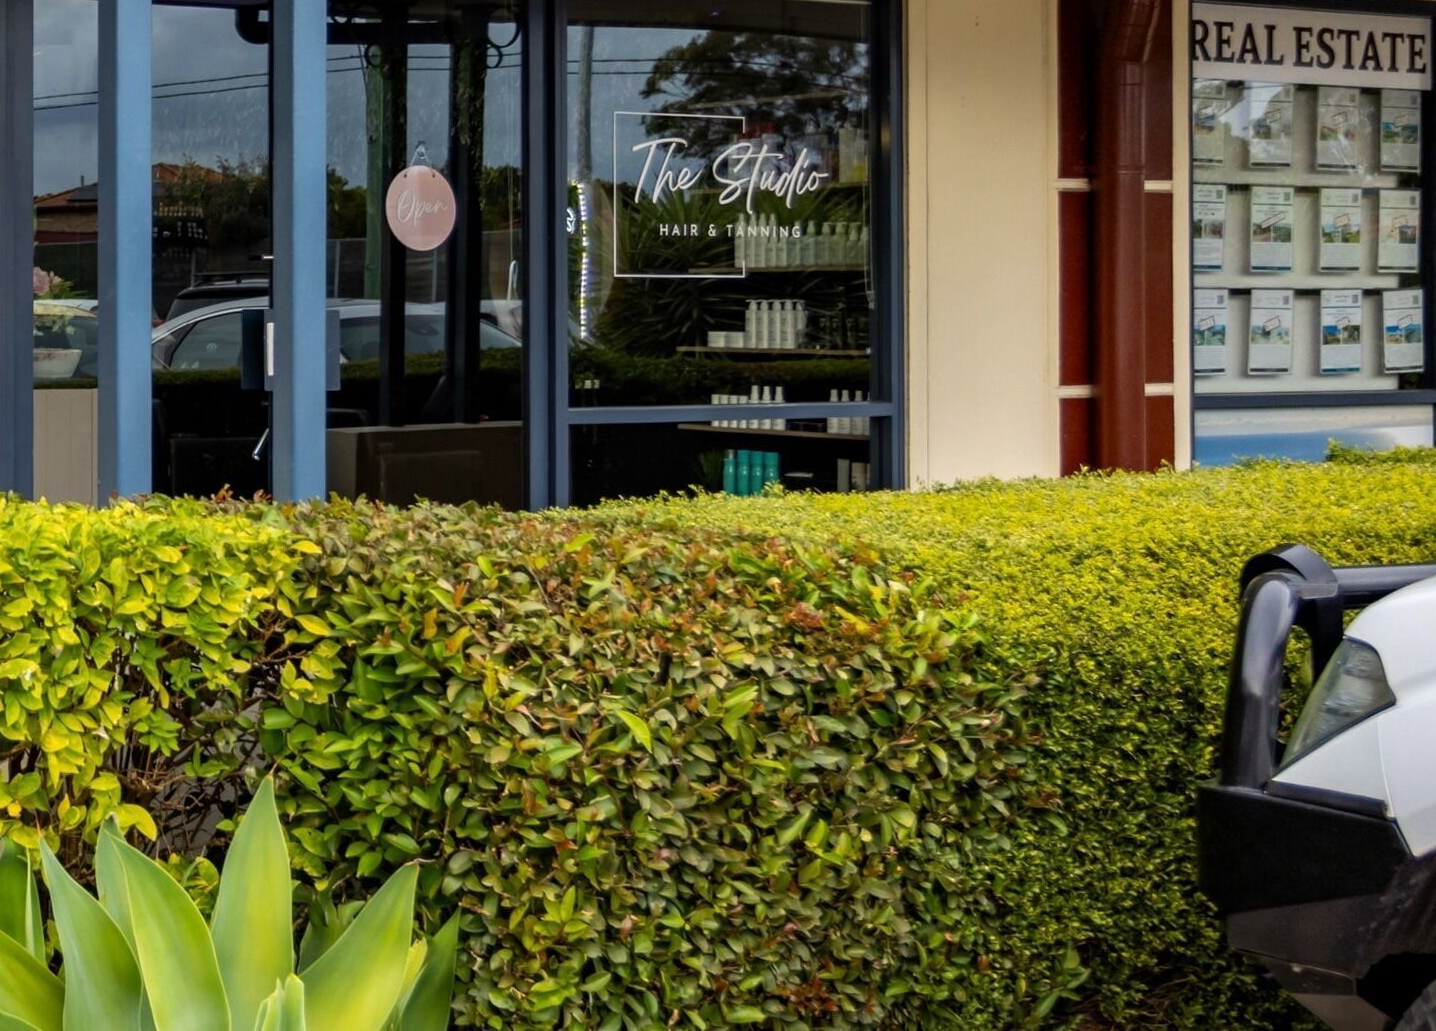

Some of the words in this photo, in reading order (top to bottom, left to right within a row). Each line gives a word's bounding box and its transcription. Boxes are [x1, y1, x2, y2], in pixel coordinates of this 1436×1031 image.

[1191, 19, 1285, 67] REAL
[1292, 25, 1427, 74] ESTATE
[631, 137, 703, 204] The
[711, 142, 829, 213] Studio
[395, 188, 449, 227] Open
[658, 222, 699, 237] HAIR
[708, 223, 718, 238] &
[725, 224, 803, 240] TANNING
